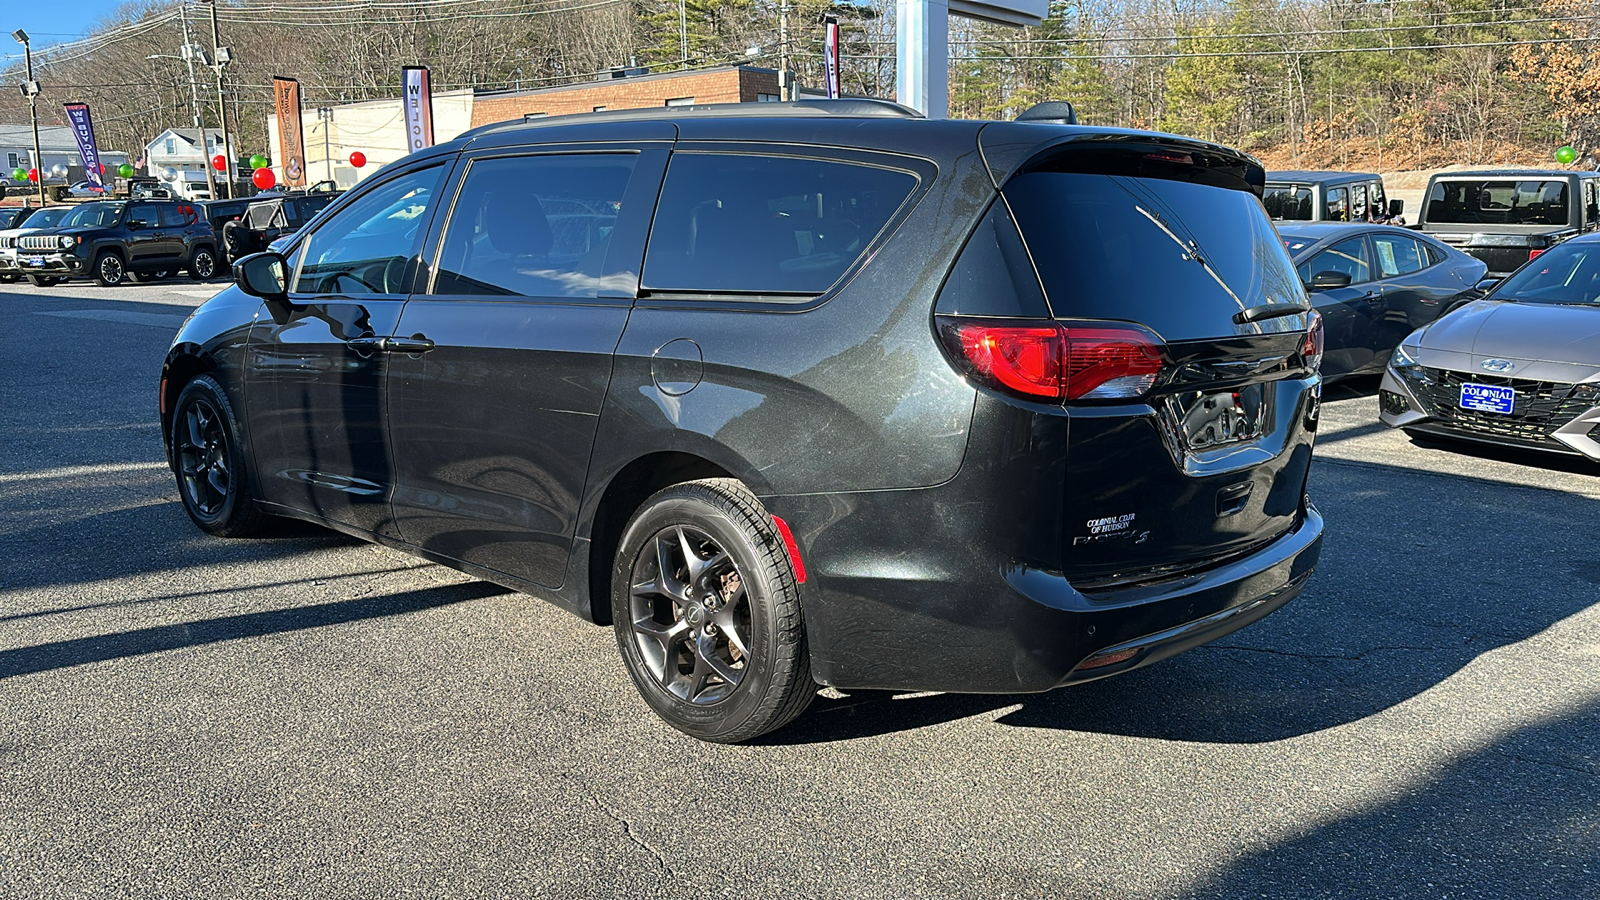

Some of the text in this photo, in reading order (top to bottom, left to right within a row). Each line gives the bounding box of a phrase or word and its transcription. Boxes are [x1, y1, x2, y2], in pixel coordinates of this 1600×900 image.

[1462, 387, 1513, 400] COLONIAL
[1087, 516, 1118, 528] COLONIAL
[1091, 521, 1130, 534] OF HUDSON
